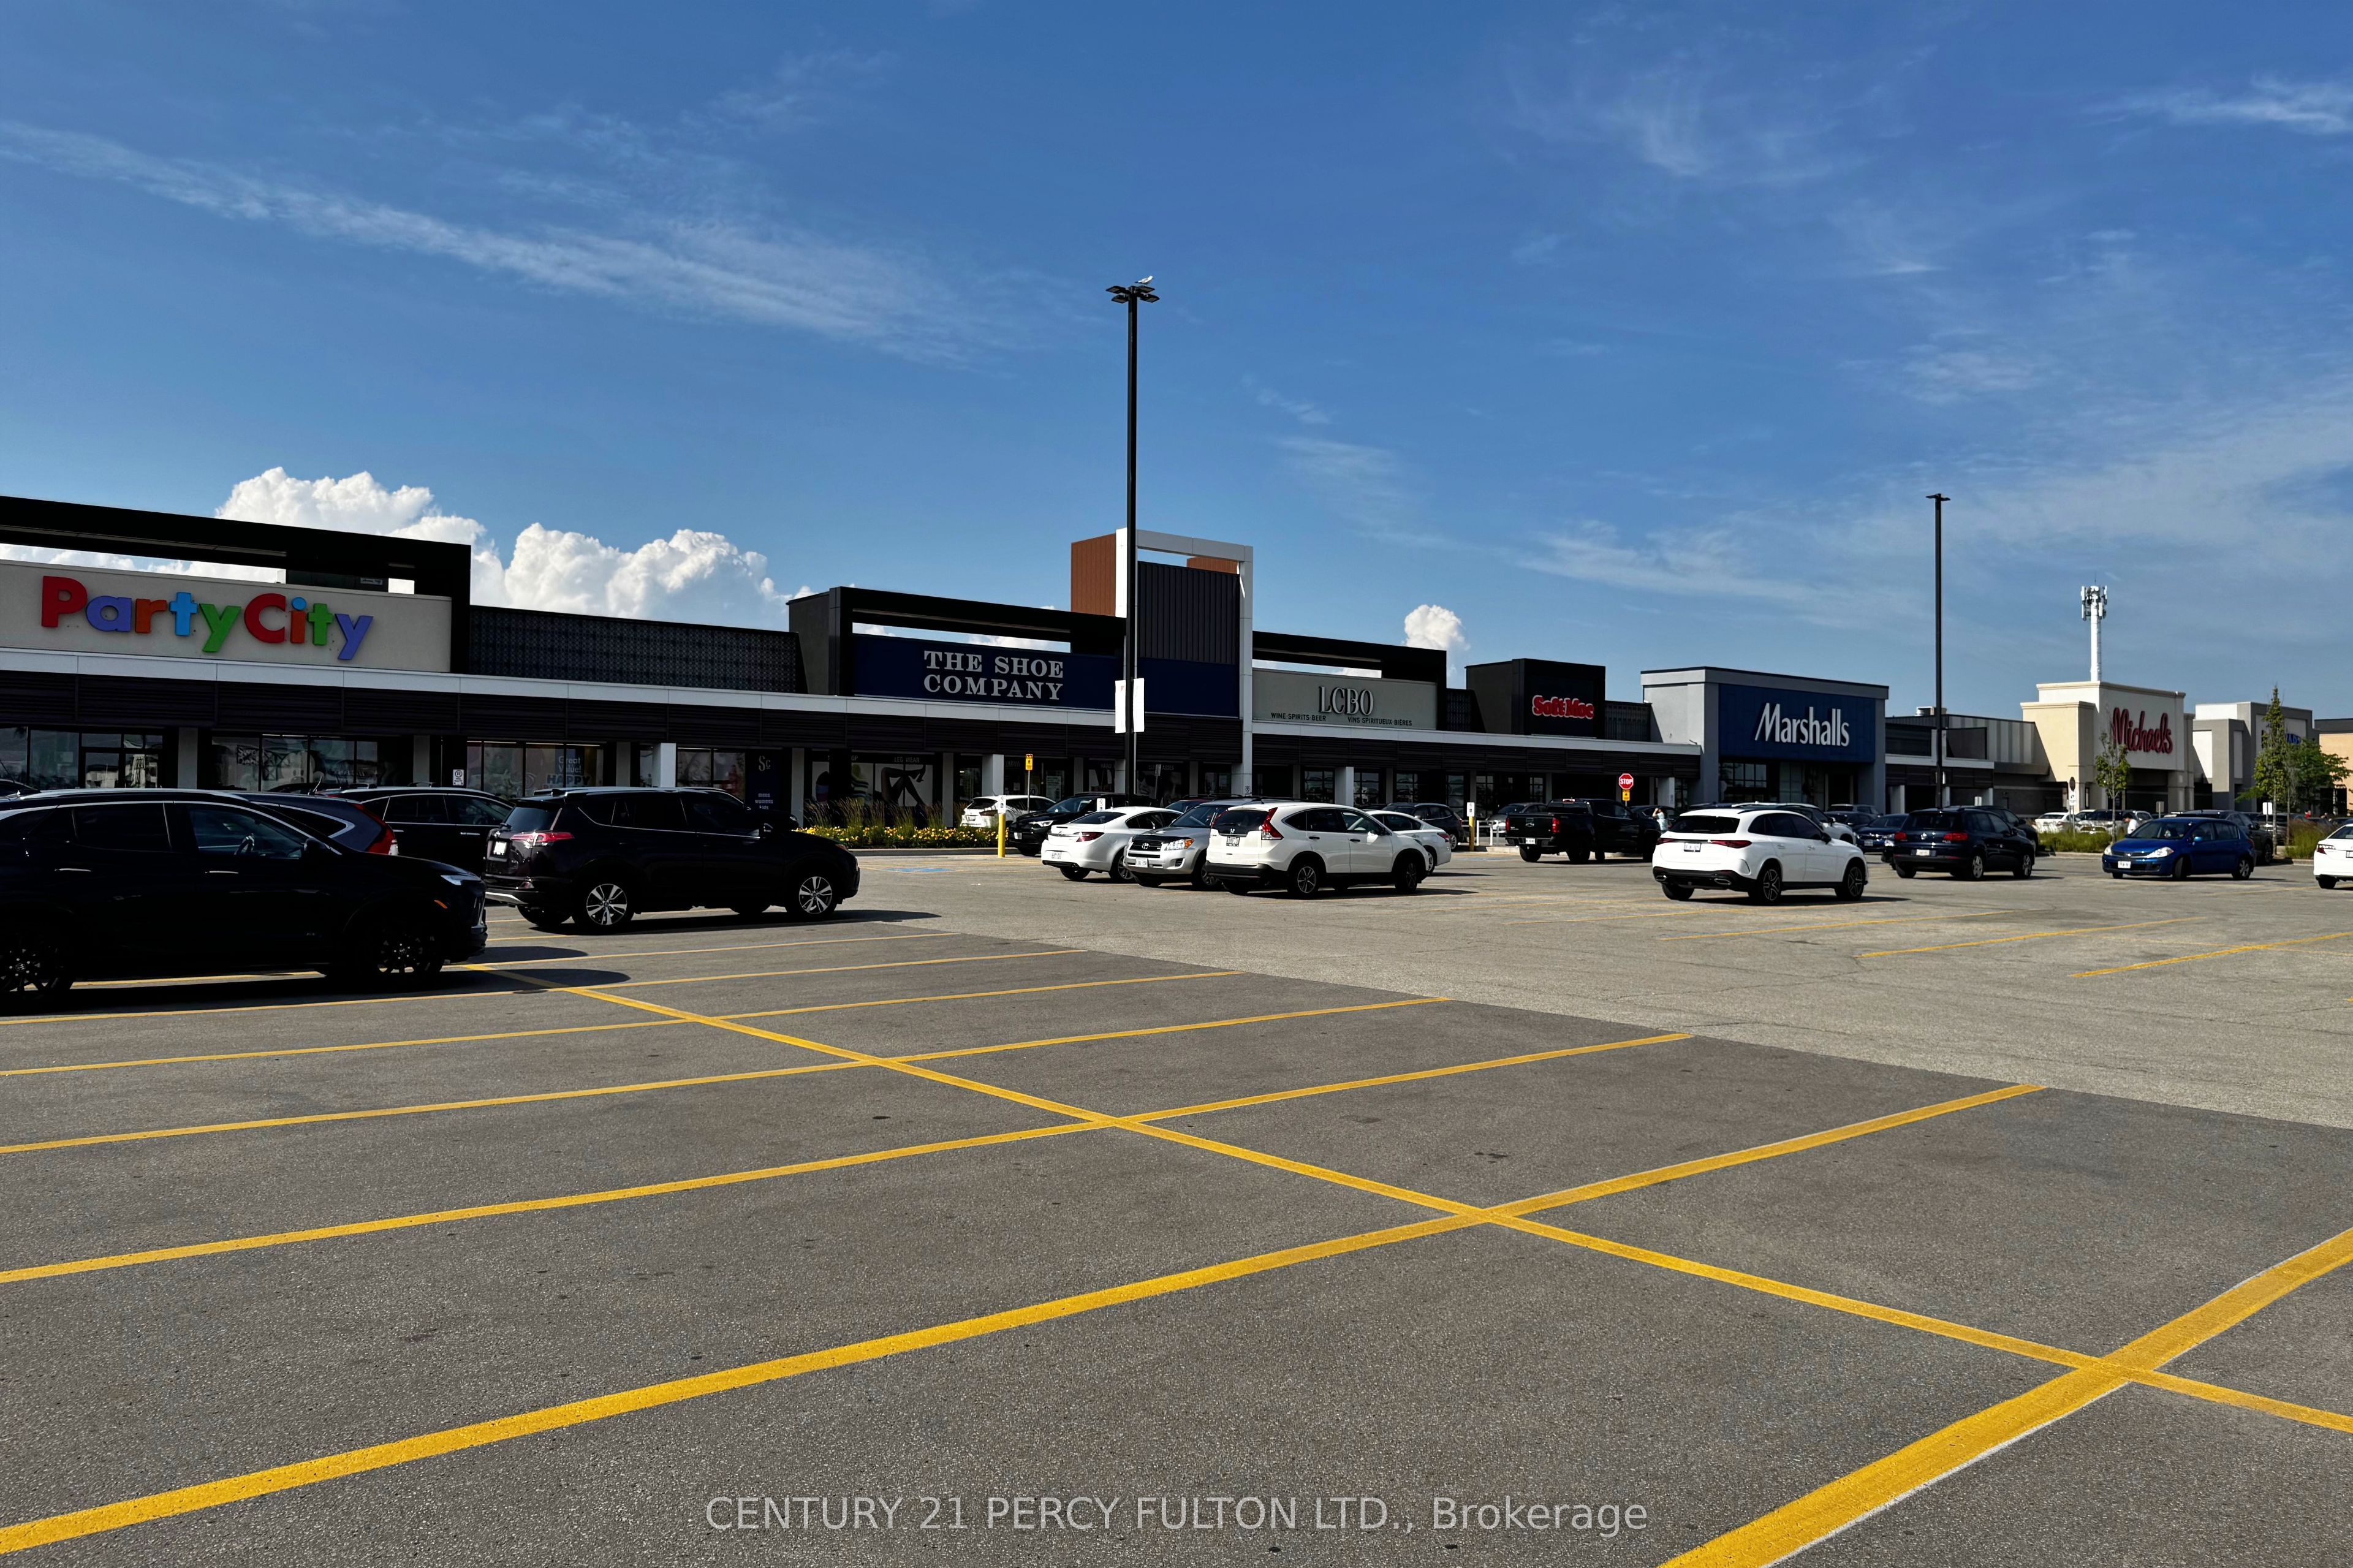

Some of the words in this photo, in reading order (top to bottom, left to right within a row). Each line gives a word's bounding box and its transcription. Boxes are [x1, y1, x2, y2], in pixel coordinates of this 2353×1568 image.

[923, 650, 982, 672] THE
[995, 656, 1063, 678] SHOE
[923, 674, 1064, 700] COMPANY
[1319, 686, 1374, 716] LCBO
[1754, 702, 1849, 747] Marshalls
[2112, 707, 2173, 754] Michaels
